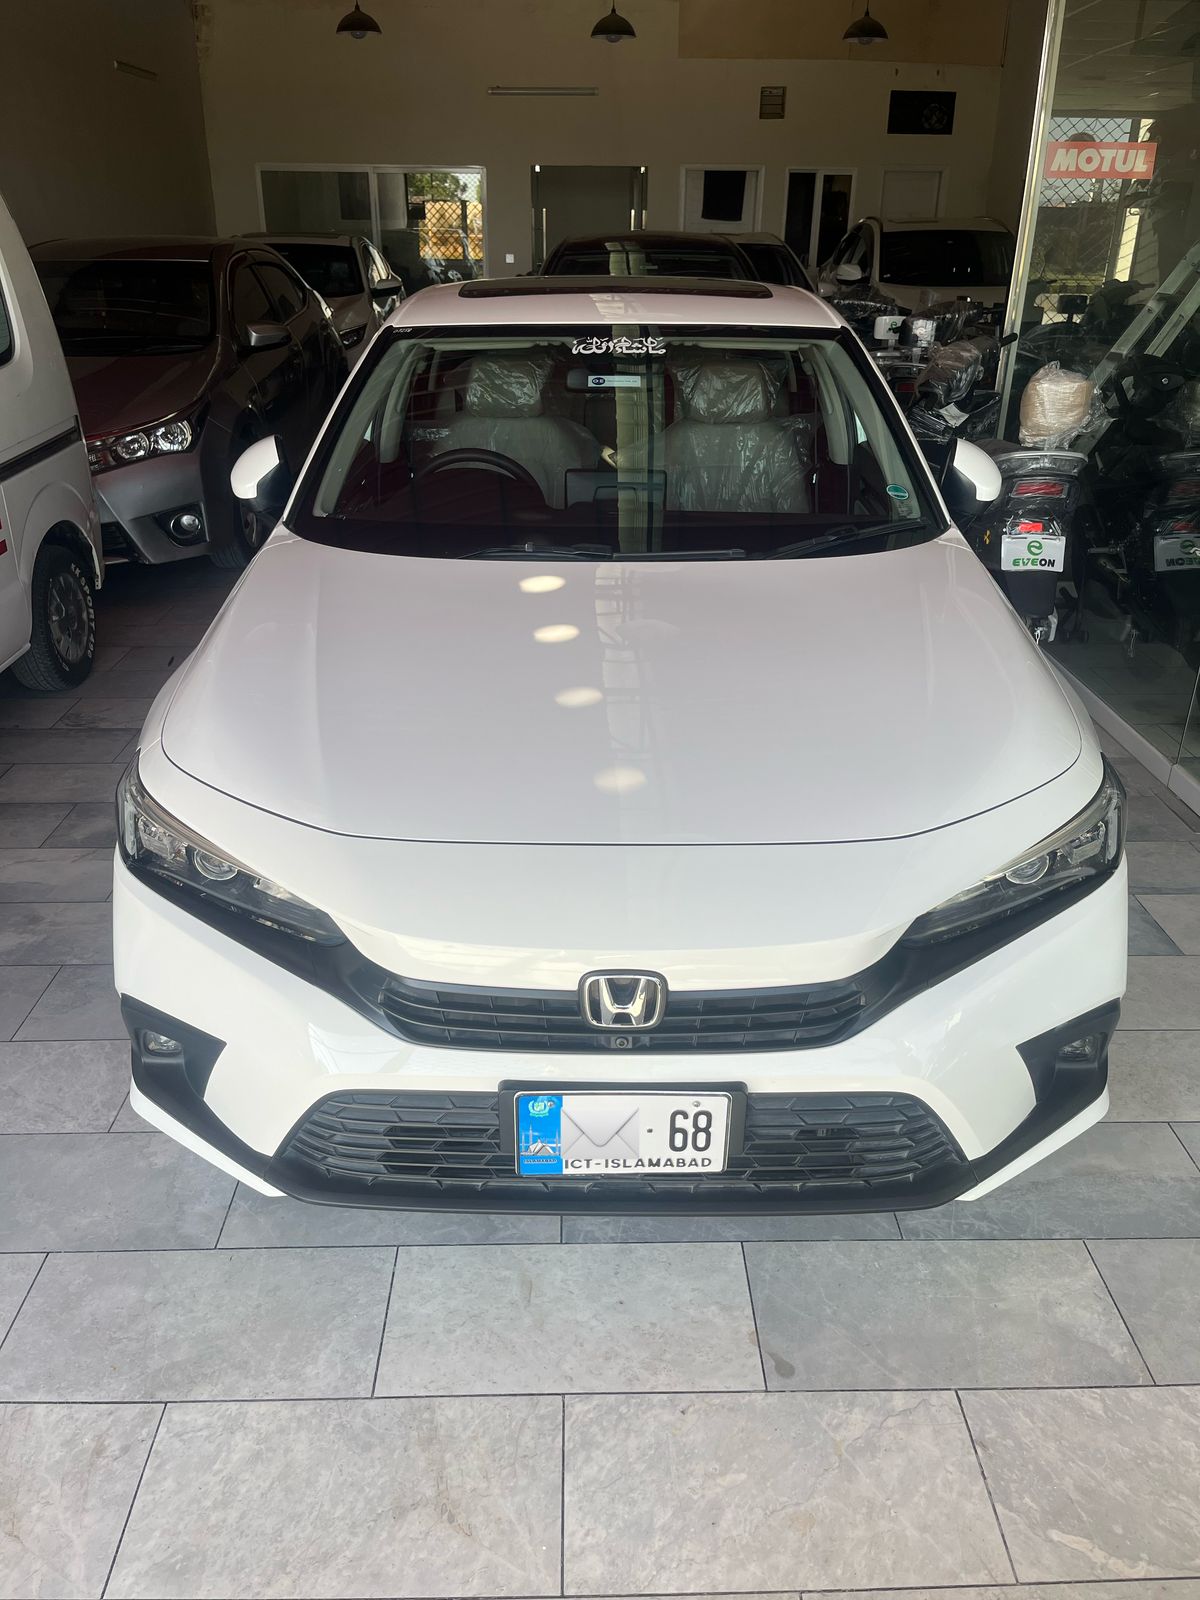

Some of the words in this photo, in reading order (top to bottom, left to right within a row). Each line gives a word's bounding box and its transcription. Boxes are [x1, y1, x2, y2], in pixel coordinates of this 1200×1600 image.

[1050, 148, 1149, 172] MOTUL
[1012, 557, 1056, 568] EVEON
[668, 1109, 713, 1152] 68
[564, 1157, 712, 1169] ICT-ISLAMABAD
